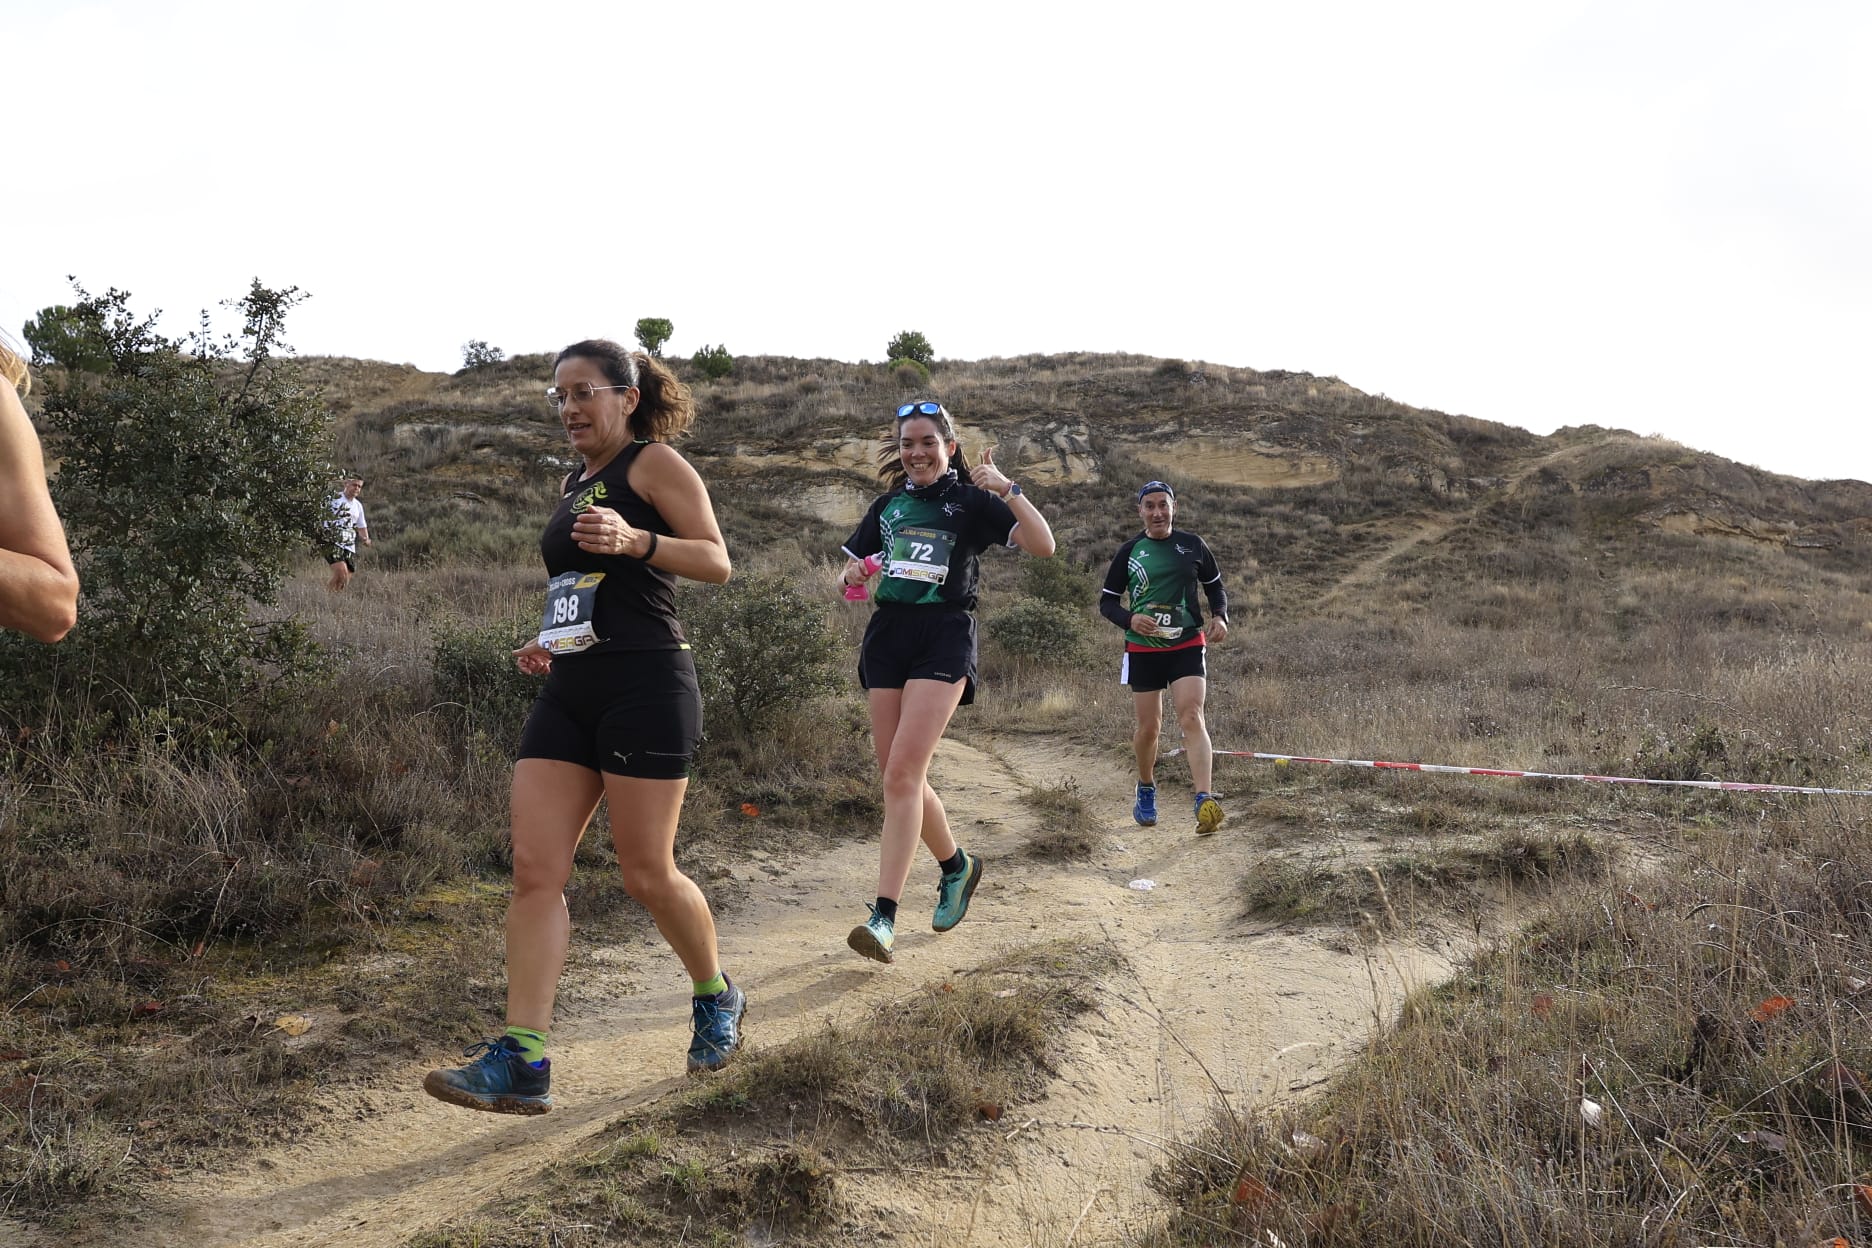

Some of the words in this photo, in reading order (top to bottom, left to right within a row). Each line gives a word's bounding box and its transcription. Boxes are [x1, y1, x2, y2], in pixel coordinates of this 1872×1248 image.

[910, 541, 933, 562] 72
[561, 577, 576, 587] CROSS
[552, 594, 579, 624] 198
[1154, 612, 1171, 626] 78
